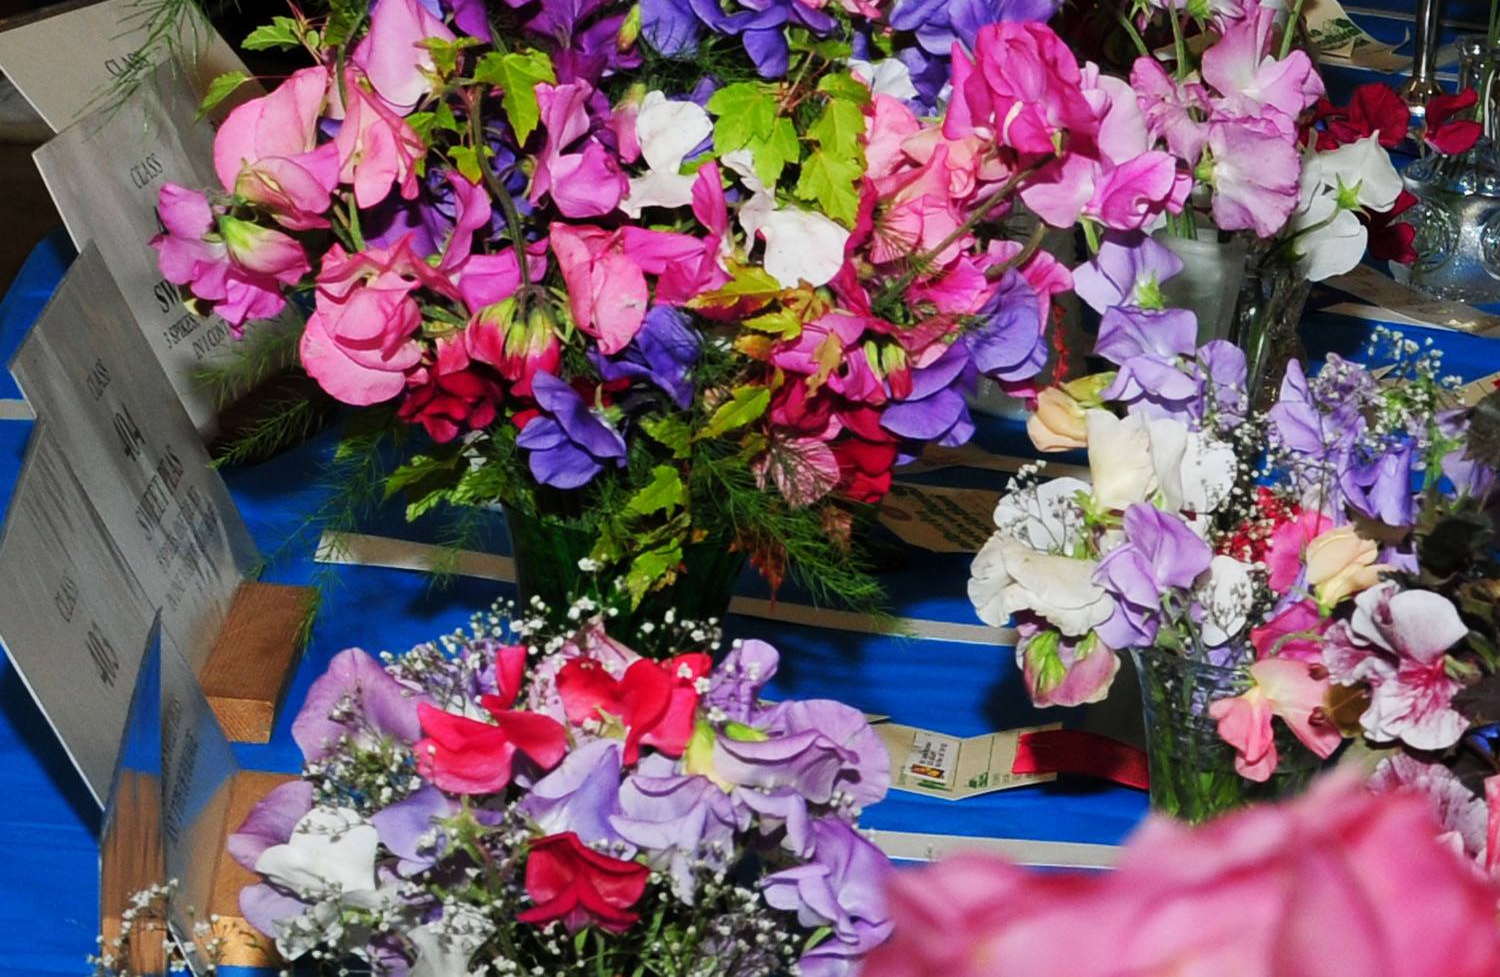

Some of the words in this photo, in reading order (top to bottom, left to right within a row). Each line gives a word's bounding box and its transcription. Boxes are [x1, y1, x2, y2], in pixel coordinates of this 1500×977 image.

[130, 153, 163, 189] CLASS
[112, 402, 146, 462] 404
[85, 619, 120, 688] 403
